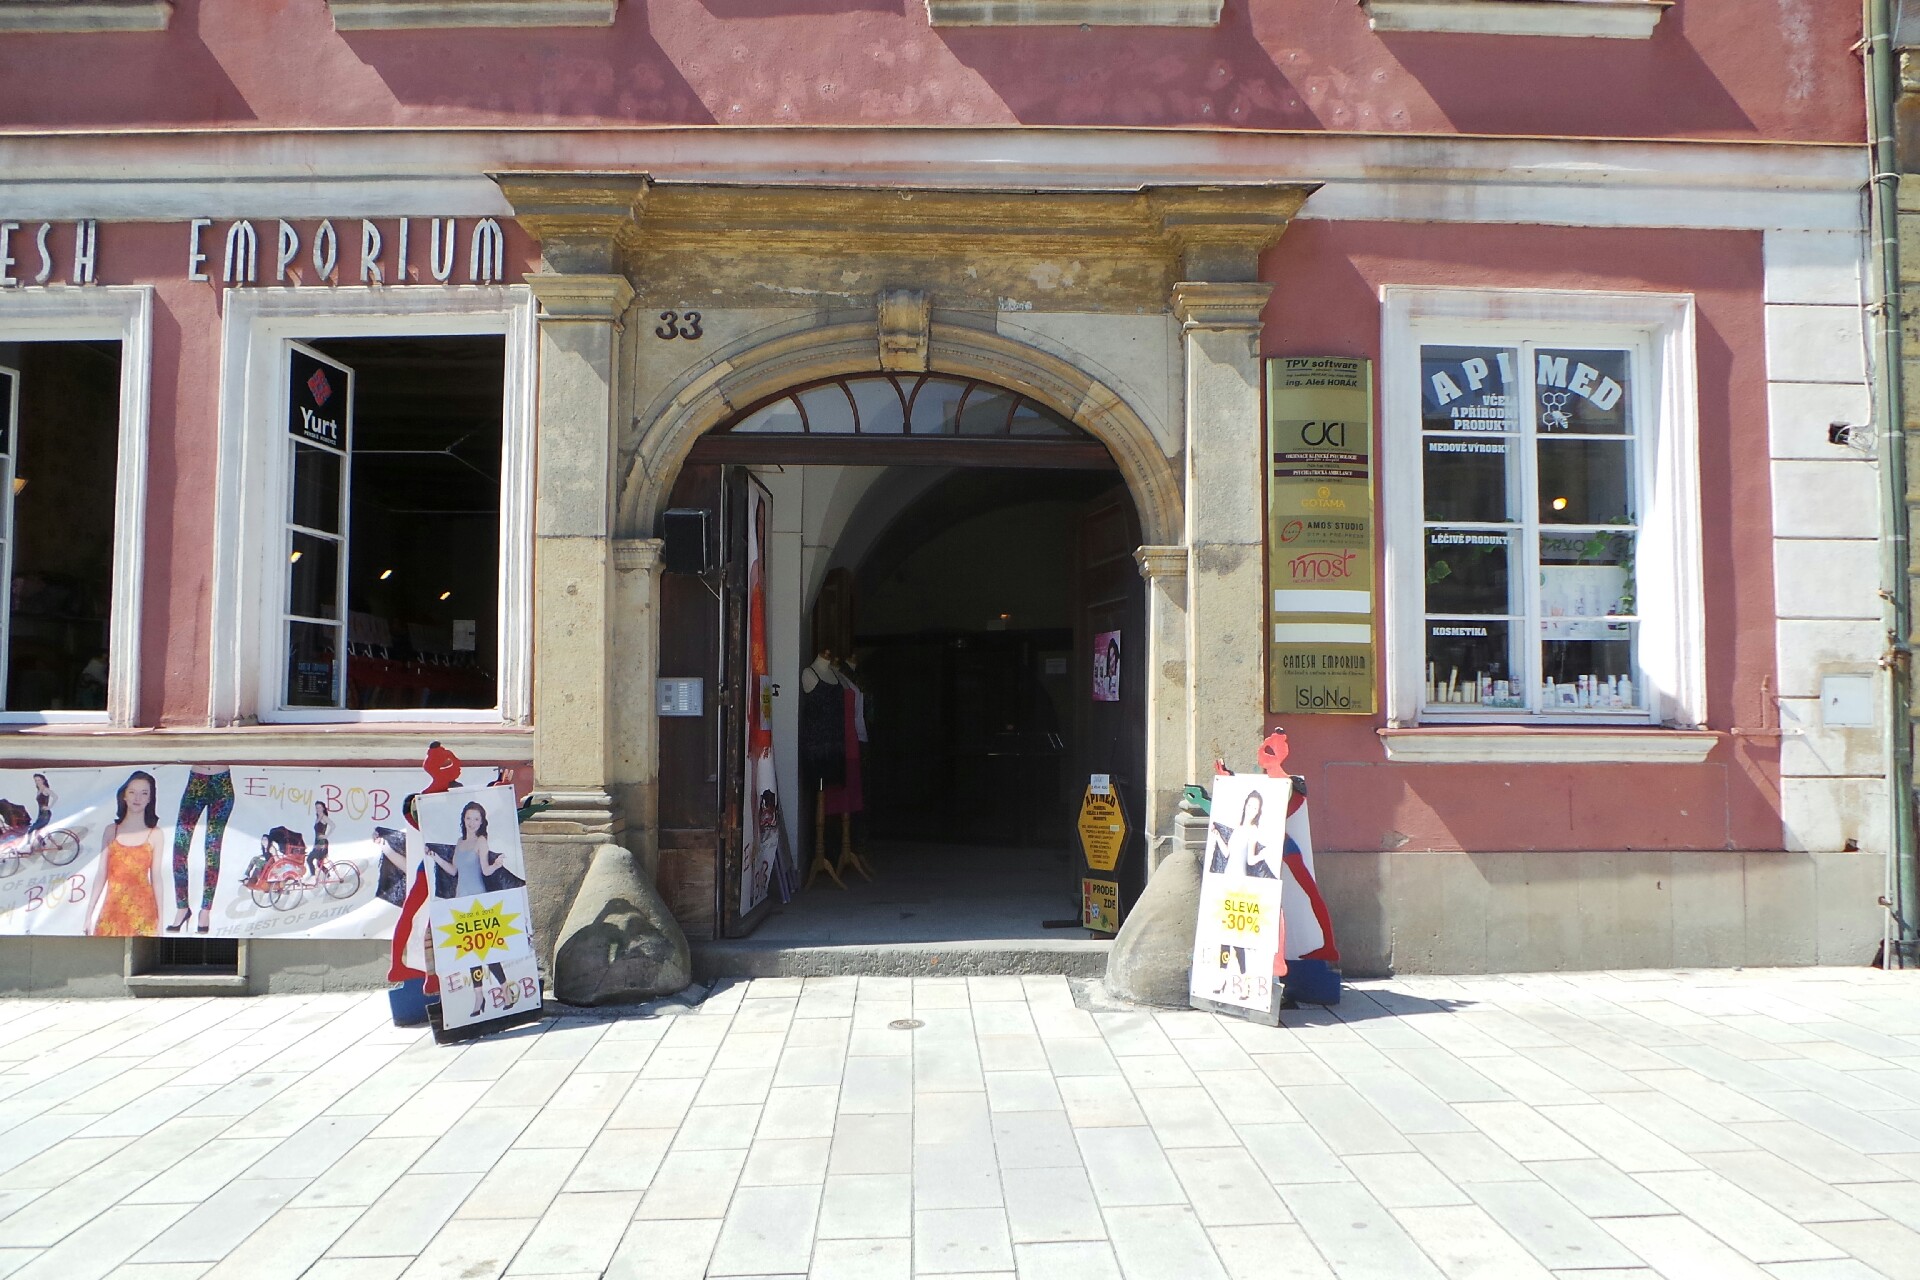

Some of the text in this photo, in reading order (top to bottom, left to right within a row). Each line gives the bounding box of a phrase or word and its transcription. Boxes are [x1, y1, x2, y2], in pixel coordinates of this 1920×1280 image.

[0, 217, 505, 286] ESH EMPORIUM
[655, 310, 704, 340] 33
[1286, 359, 1358, 370] TPV software
[1286, 378, 1358, 388] ing. Aleš HORÁK
[1431, 352, 1623, 411] API MED
[1450, 406, 1460, 418] A
[299, 405, 338, 440] Yurt
[1454, 420, 1518, 431] PRODUKTY
[1429, 441, 1511, 453] MEDOVÉ VÝROBKY
[1301, 498, 1346, 509] GOTAMA
[1307, 521, 1364, 531] AMOS STUDIO
[1431, 534, 1515, 545] LÉČIVÉ PRODUKTY
[1288, 549, 1356, 580] most
[1432, 627, 1488, 637] KOSMETIKA
[1283, 655, 1366, 669] GANESH EMPORIUM
[243, 777, 391, 821] Enjoy BOB
[24, 874, 86, 912] BOB
[1092, 884, 1116, 897] PRODEJ
[1103, 898, 1116, 910] ZDE
[1224, 899, 1260, 914] SLEVA
[215, 904, 354, 937] THE BEST OF BATIK
[456, 916, 501, 935] SLEVA
[1221, 913, 1261, 934] -30%
[456, 930, 505, 952] -30%
[488, 976, 537, 1009] BOB
